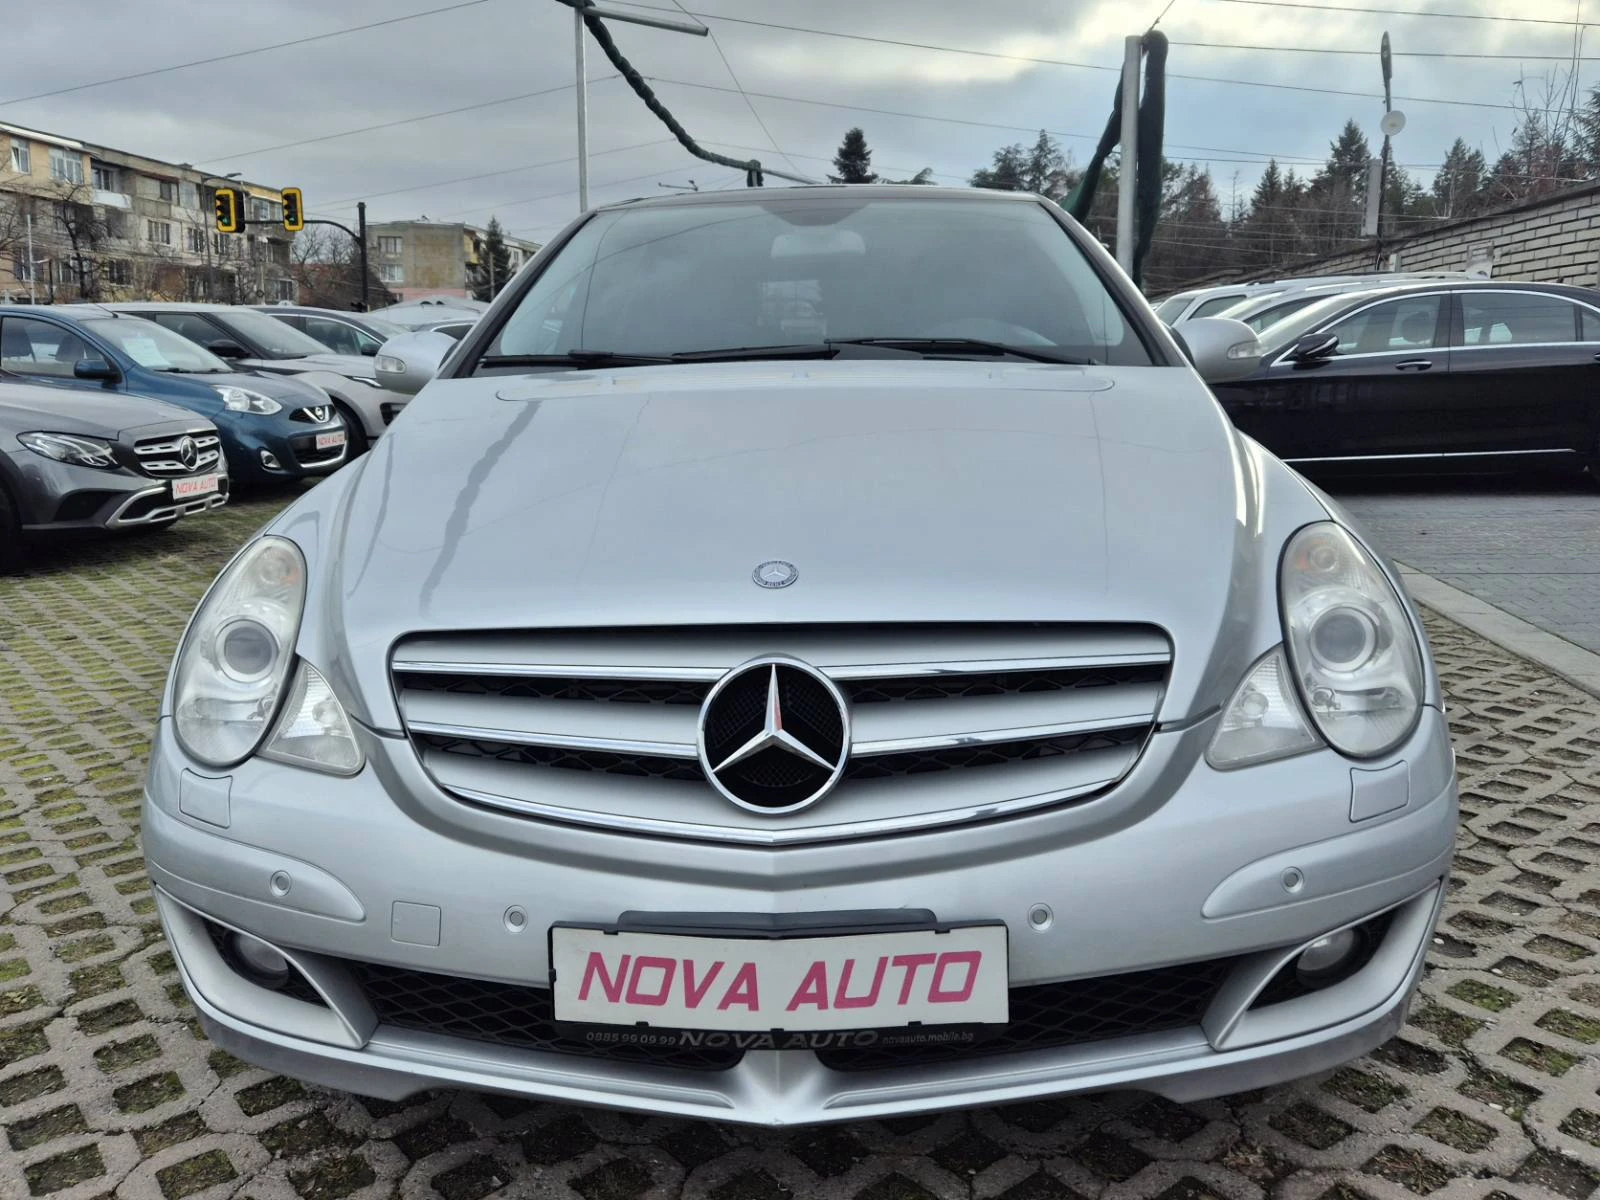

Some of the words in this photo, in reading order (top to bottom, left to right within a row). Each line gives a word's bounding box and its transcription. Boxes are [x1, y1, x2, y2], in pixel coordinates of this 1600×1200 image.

[175, 481, 199, 495] NOVA
[200, 477, 217, 490] AUTO
[578, 951, 759, 1012] NOVA
[785, 950, 982, 1012] AUTO
[678, 1030, 776, 1049] NOVA
[782, 1030, 879, 1049] AUTO
